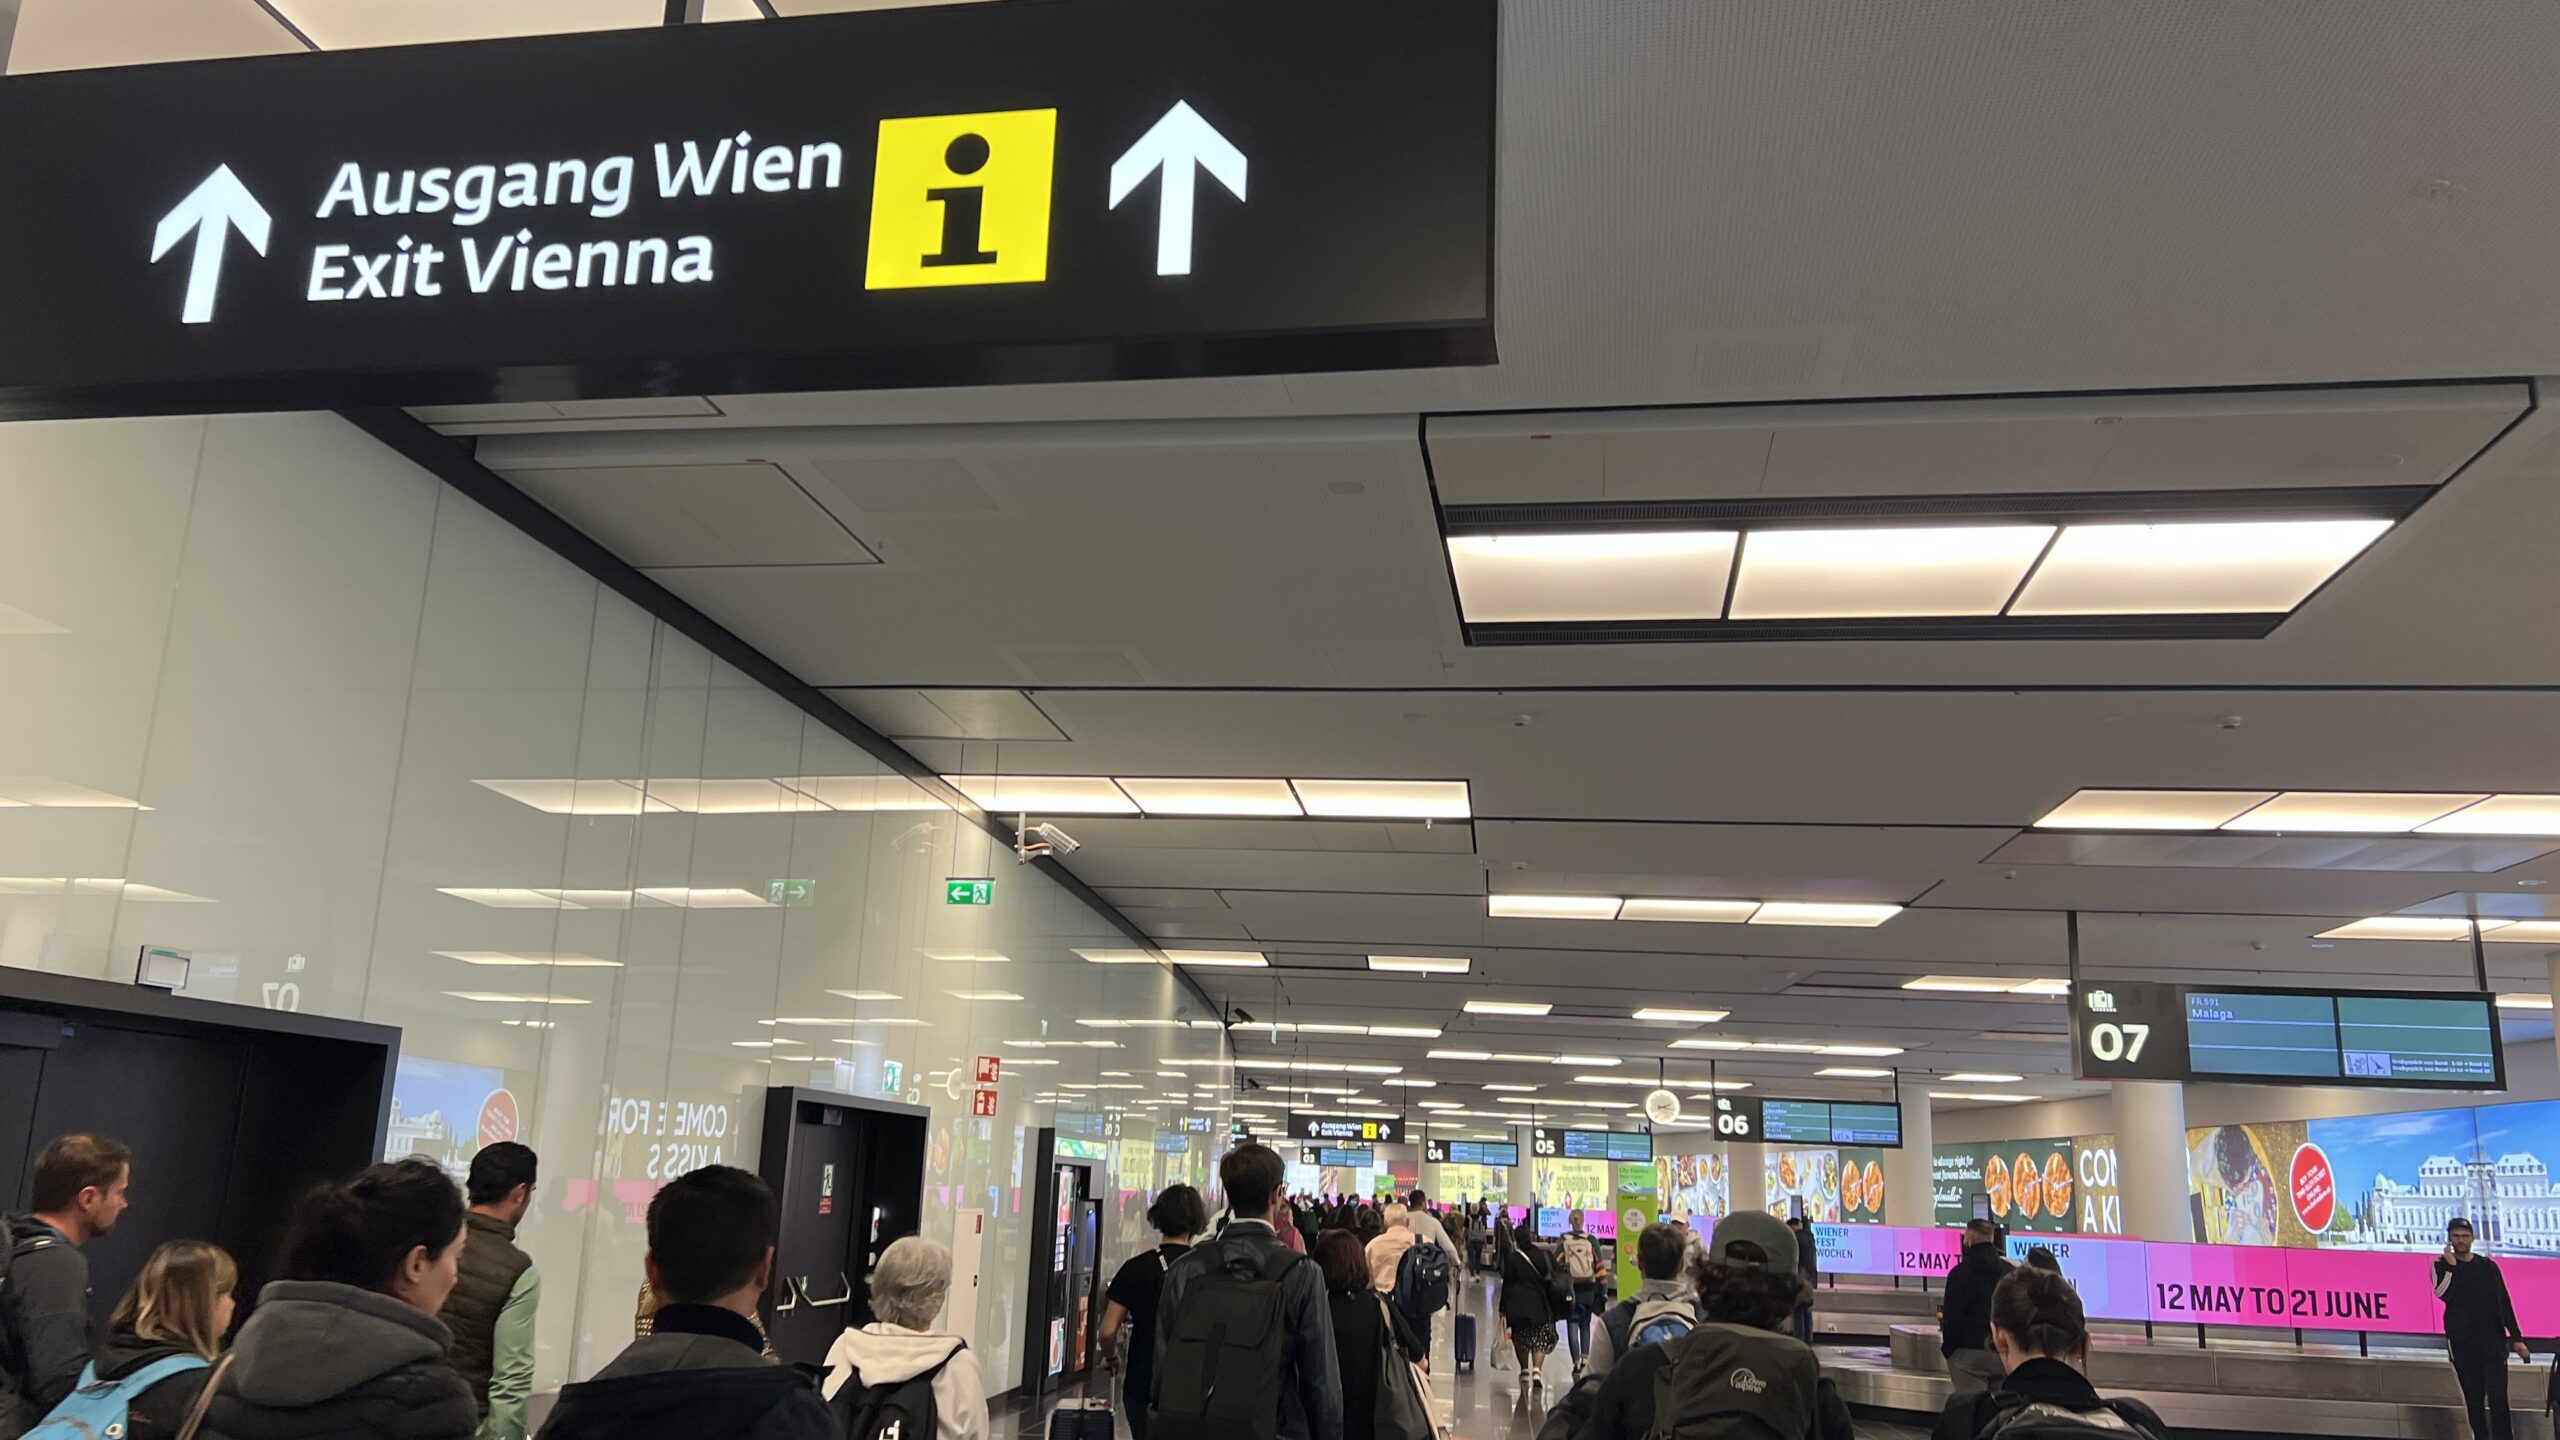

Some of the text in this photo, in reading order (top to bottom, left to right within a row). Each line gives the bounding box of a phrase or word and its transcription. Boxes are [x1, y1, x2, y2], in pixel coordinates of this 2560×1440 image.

[316, 130, 843, 225] Ausgang Wien
[307, 228, 713, 301] Exit Vienna
[2192, 1008, 2234, 1021] Malaga
[2090, 1022, 2149, 1063] 07
[1321, 1122, 1362, 1132] Ausgang Wien
[1718, 1114, 1749, 1135] 06
[1535, 1140, 1556, 1154] 05
[1303, 1153, 1316, 1163] 03
[1427, 1148, 1444, 1160] 04
[2083, 1195, 2098, 1233] A
[1586, 1223, 1615, 1235] 12 MAY
[1815, 1226, 1849, 1237] WIENER
[1815, 1237, 1836, 1247] FEST
[1817, 1248, 1853, 1259] WOCHEN
[1899, 1251, 1916, 1269] 12
[1919, 1253, 1951, 1270] MAY
[2157, 1283, 2390, 1320] 12 MAY TO 21 JUNE
[1735, 1381, 1762, 1394] alpine
[1743, 1375, 1767, 1388] Lowe
